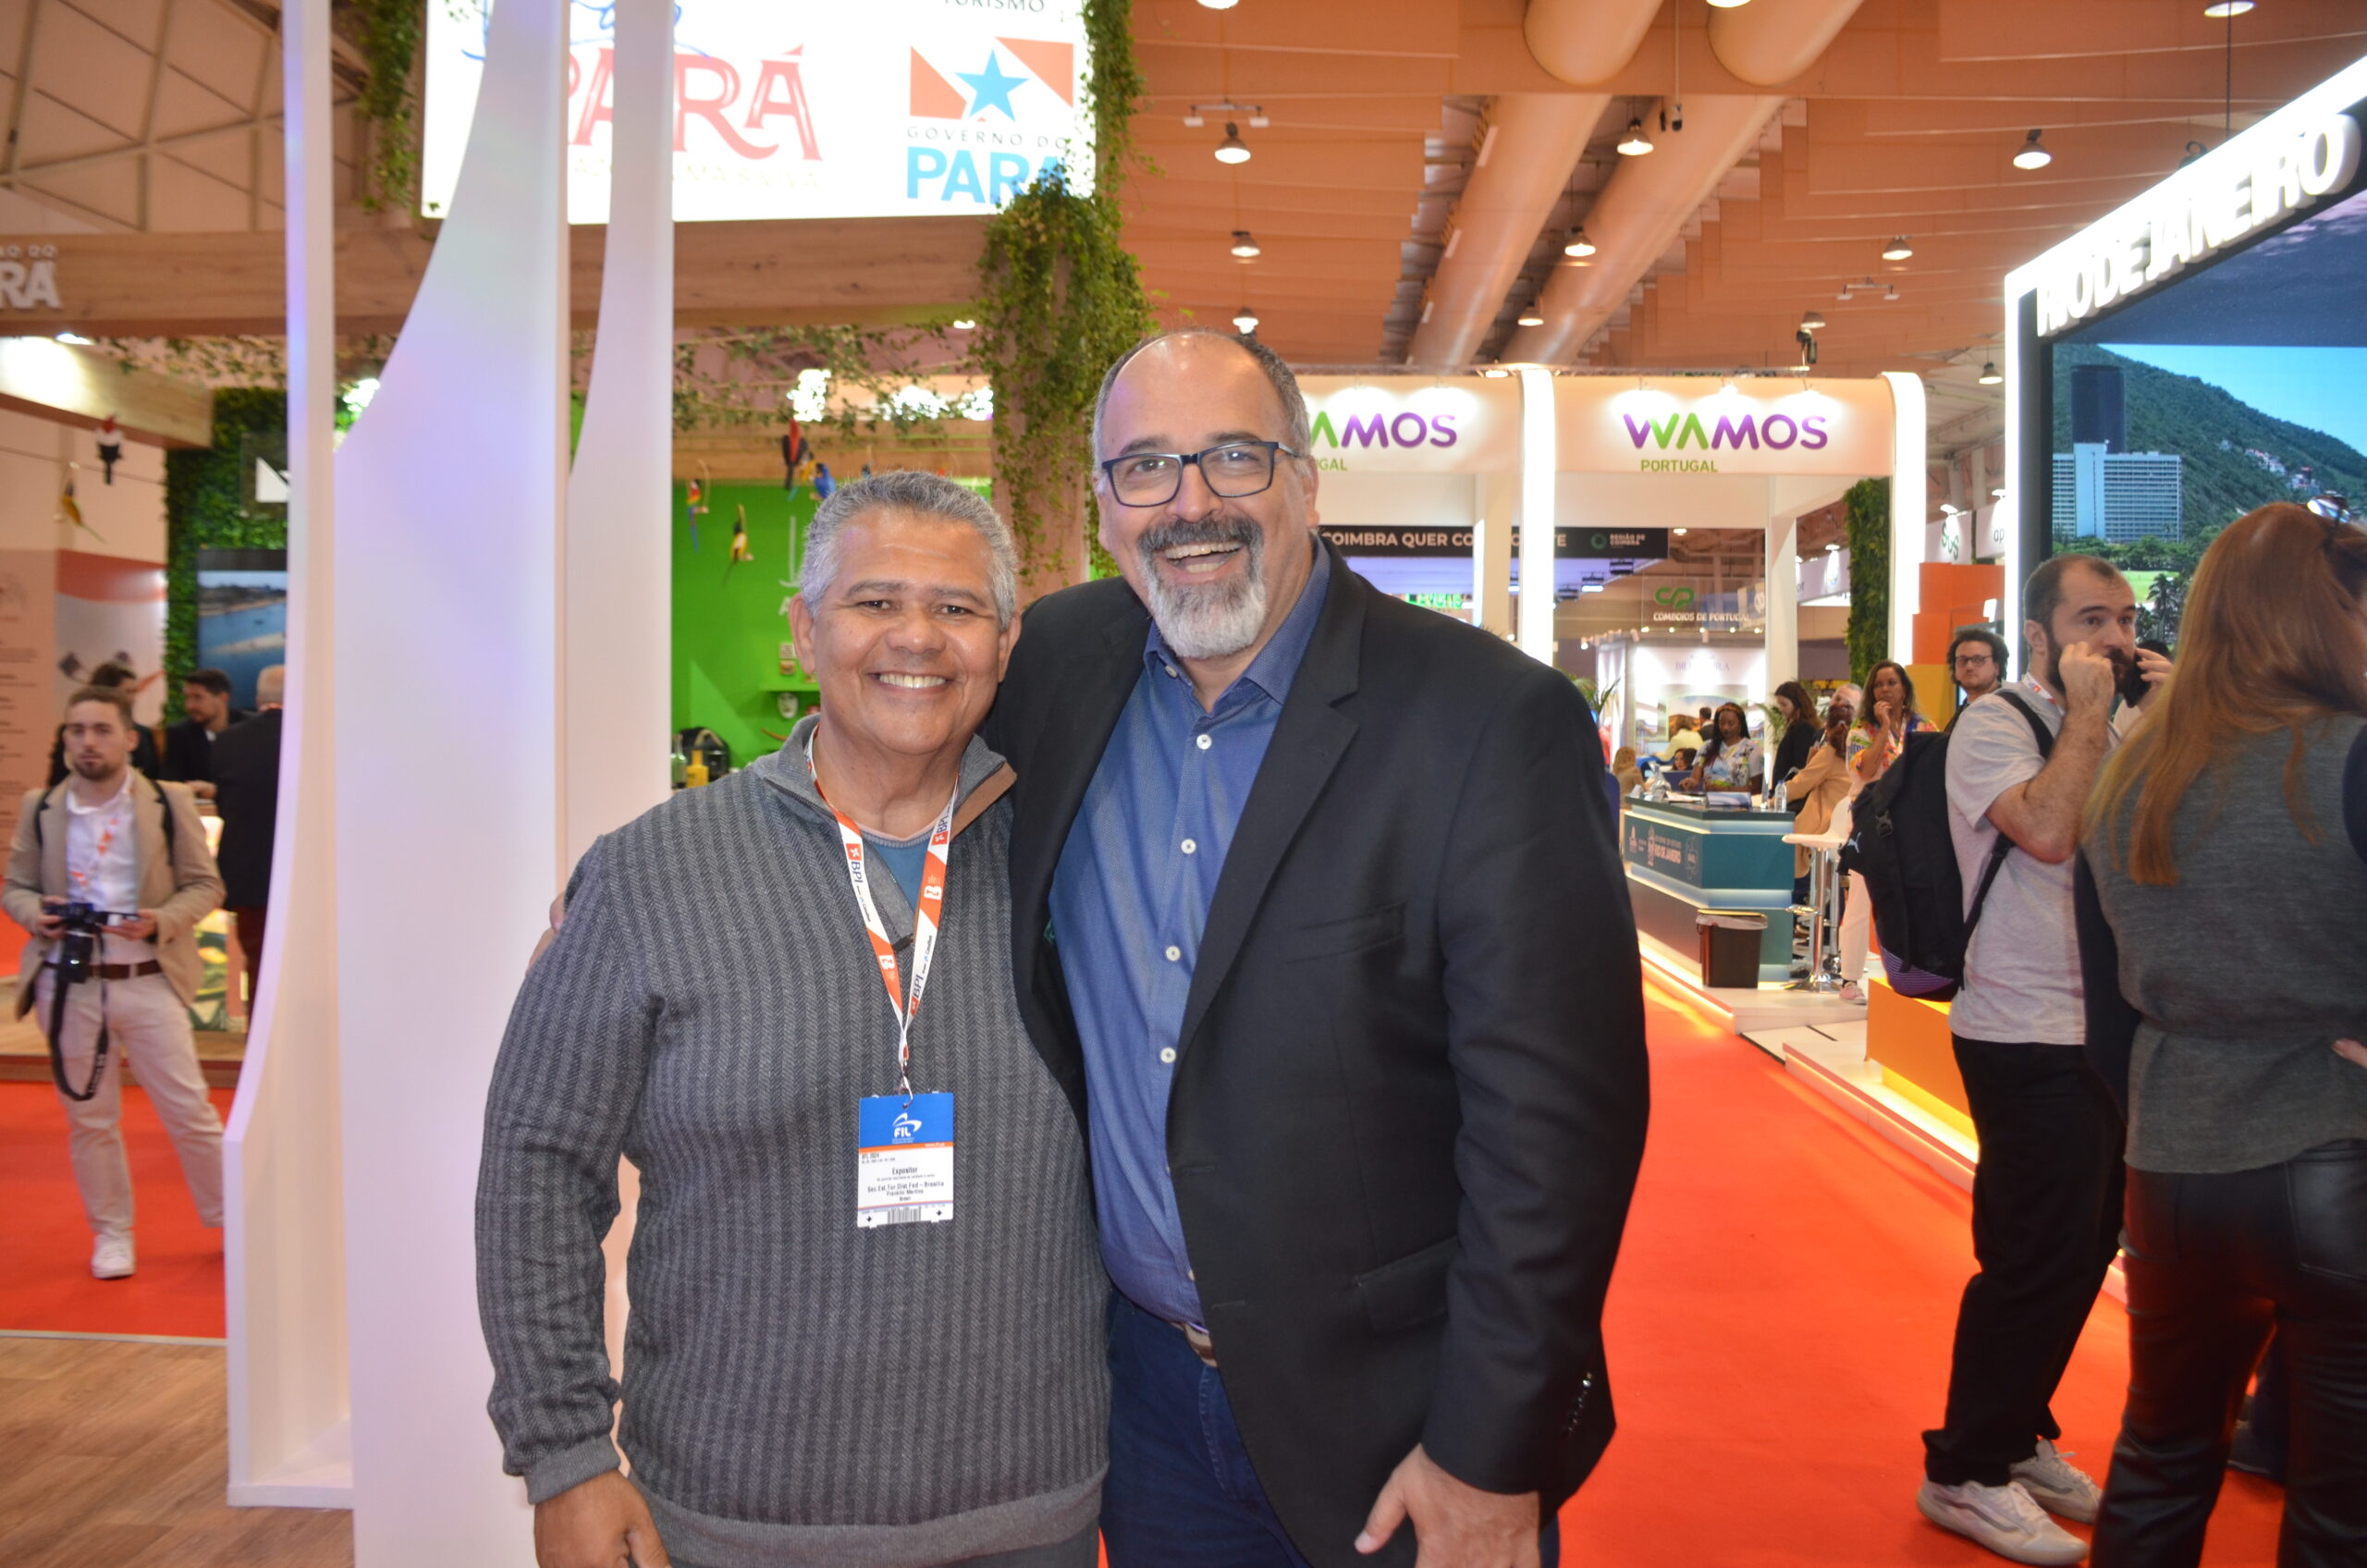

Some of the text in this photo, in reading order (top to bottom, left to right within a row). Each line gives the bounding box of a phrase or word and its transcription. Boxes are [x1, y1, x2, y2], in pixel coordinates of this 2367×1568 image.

[907, 126, 1068, 151] GOVERNO DO
[1310, 410, 1457, 448] AMOS
[1623, 412, 1828, 450] WAMOS
[1640, 459, 1719, 472] PORTUGAL
[1402, 533, 1448, 547] QUER
[1653, 612, 1749, 622] COMBOIOS DE PORTUGAL
[851, 861, 864, 884] BPI
[914, 974, 924, 998] BPI
[894, 1127, 911, 1138] FIL
[891, 1167, 918, 1175] Expositor
